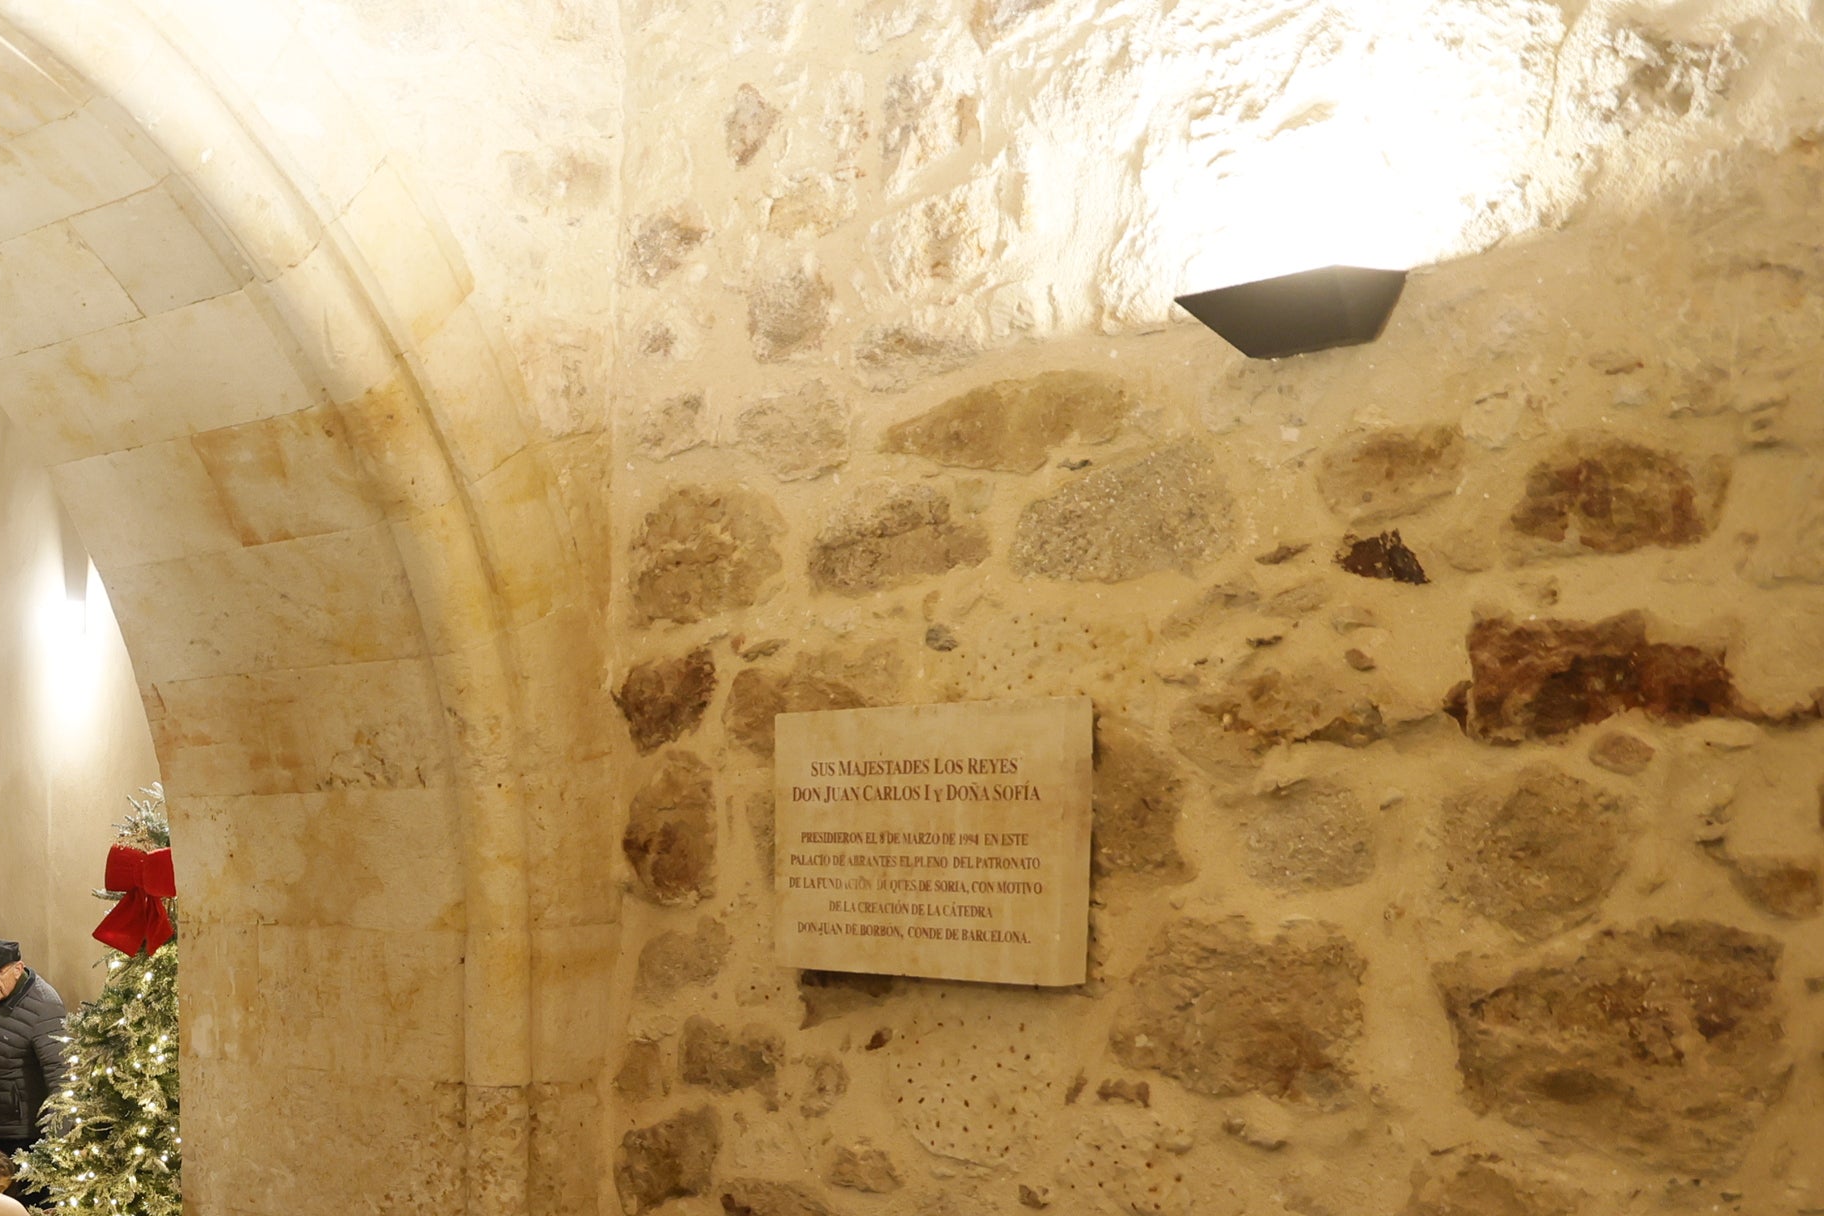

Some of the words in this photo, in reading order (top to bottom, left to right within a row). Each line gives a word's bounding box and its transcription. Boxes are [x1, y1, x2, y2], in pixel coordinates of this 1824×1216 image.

[811, 761, 836, 777] SUS
[838, 759, 930, 777] MAJESTADES
[934, 758, 964, 775] LOS
[968, 757, 1018, 775] REYES
[793, 786, 821, 802] DON
[823, 785, 860, 803] JUAN
[862, 784, 921, 802] CARLOS
[924, 783, 930, 801] I
[933, 788, 943, 803] Y
[946, 781, 990, 801] DOÑA
[993, 779, 1041, 801] SOFÍA
[801, 831, 863, 845] PRESIDIERON
[866, 831, 878, 845] EL
[887, 831, 901, 845] DE
[902, 831, 940, 845] MARZO
[942, 832, 955, 846] DE
[984, 833, 998, 847] EN
[1001, 833, 1029, 847] ESTE
[790, 854, 831, 867] PALACIO
[833, 854, 846, 867] DE
[848, 855, 897, 868] ABRANTES
[899, 855, 912, 868] EL
[914, 855, 948, 869] PLENO
[953, 856, 974, 870] DEL
[975, 856, 1041, 870] PATRONATO
[789, 876, 801, 889] DE
[803, 876, 816, 890] LA
[876, 879, 917, 894] DUQUES
[919, 880, 932, 892] DE
[934, 880, 969, 895] SORIA,
[971, 881, 994, 894] CON
[996, 881, 1043, 895] MOTIVO
[829, 900, 842, 912] DE
[844, 901, 856, 913] LA
[858, 899, 909, 914] CREACIÓN
[911, 903, 925, 916] DE
[927, 904, 941, 917] LA
[942, 901, 993, 918] CÁTEDRA
[797, 921, 816, 934] DON
[818, 922, 843, 936] JUAN
[845, 923, 857, 935] DE
[907, 926, 943, 940] CONDE
[945, 928, 959, 941] DE
[961, 929, 1032, 944] BARCELONA.
